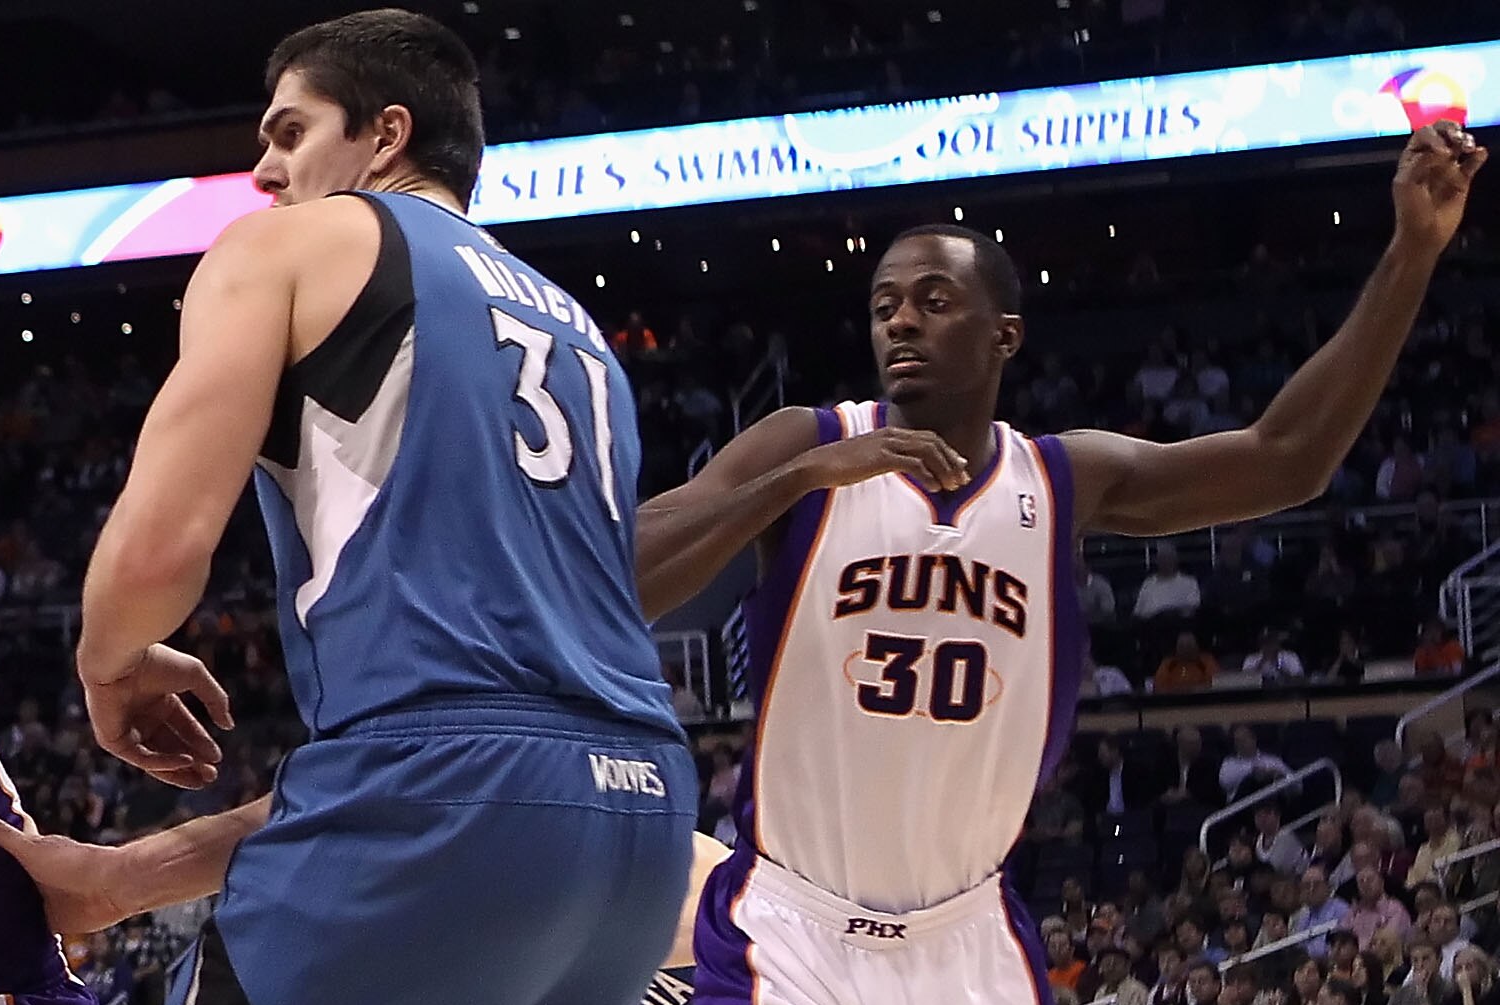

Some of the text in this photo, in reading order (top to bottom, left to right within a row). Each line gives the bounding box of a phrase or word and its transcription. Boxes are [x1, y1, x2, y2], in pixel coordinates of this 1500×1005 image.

[1019, 104, 1201, 153] SUPPLIES
[488, 304, 621, 522] 31
[832, 554, 1029, 640] SUNS
[855, 628, 990, 725] 30
[844, 917, 907, 939] PHX
